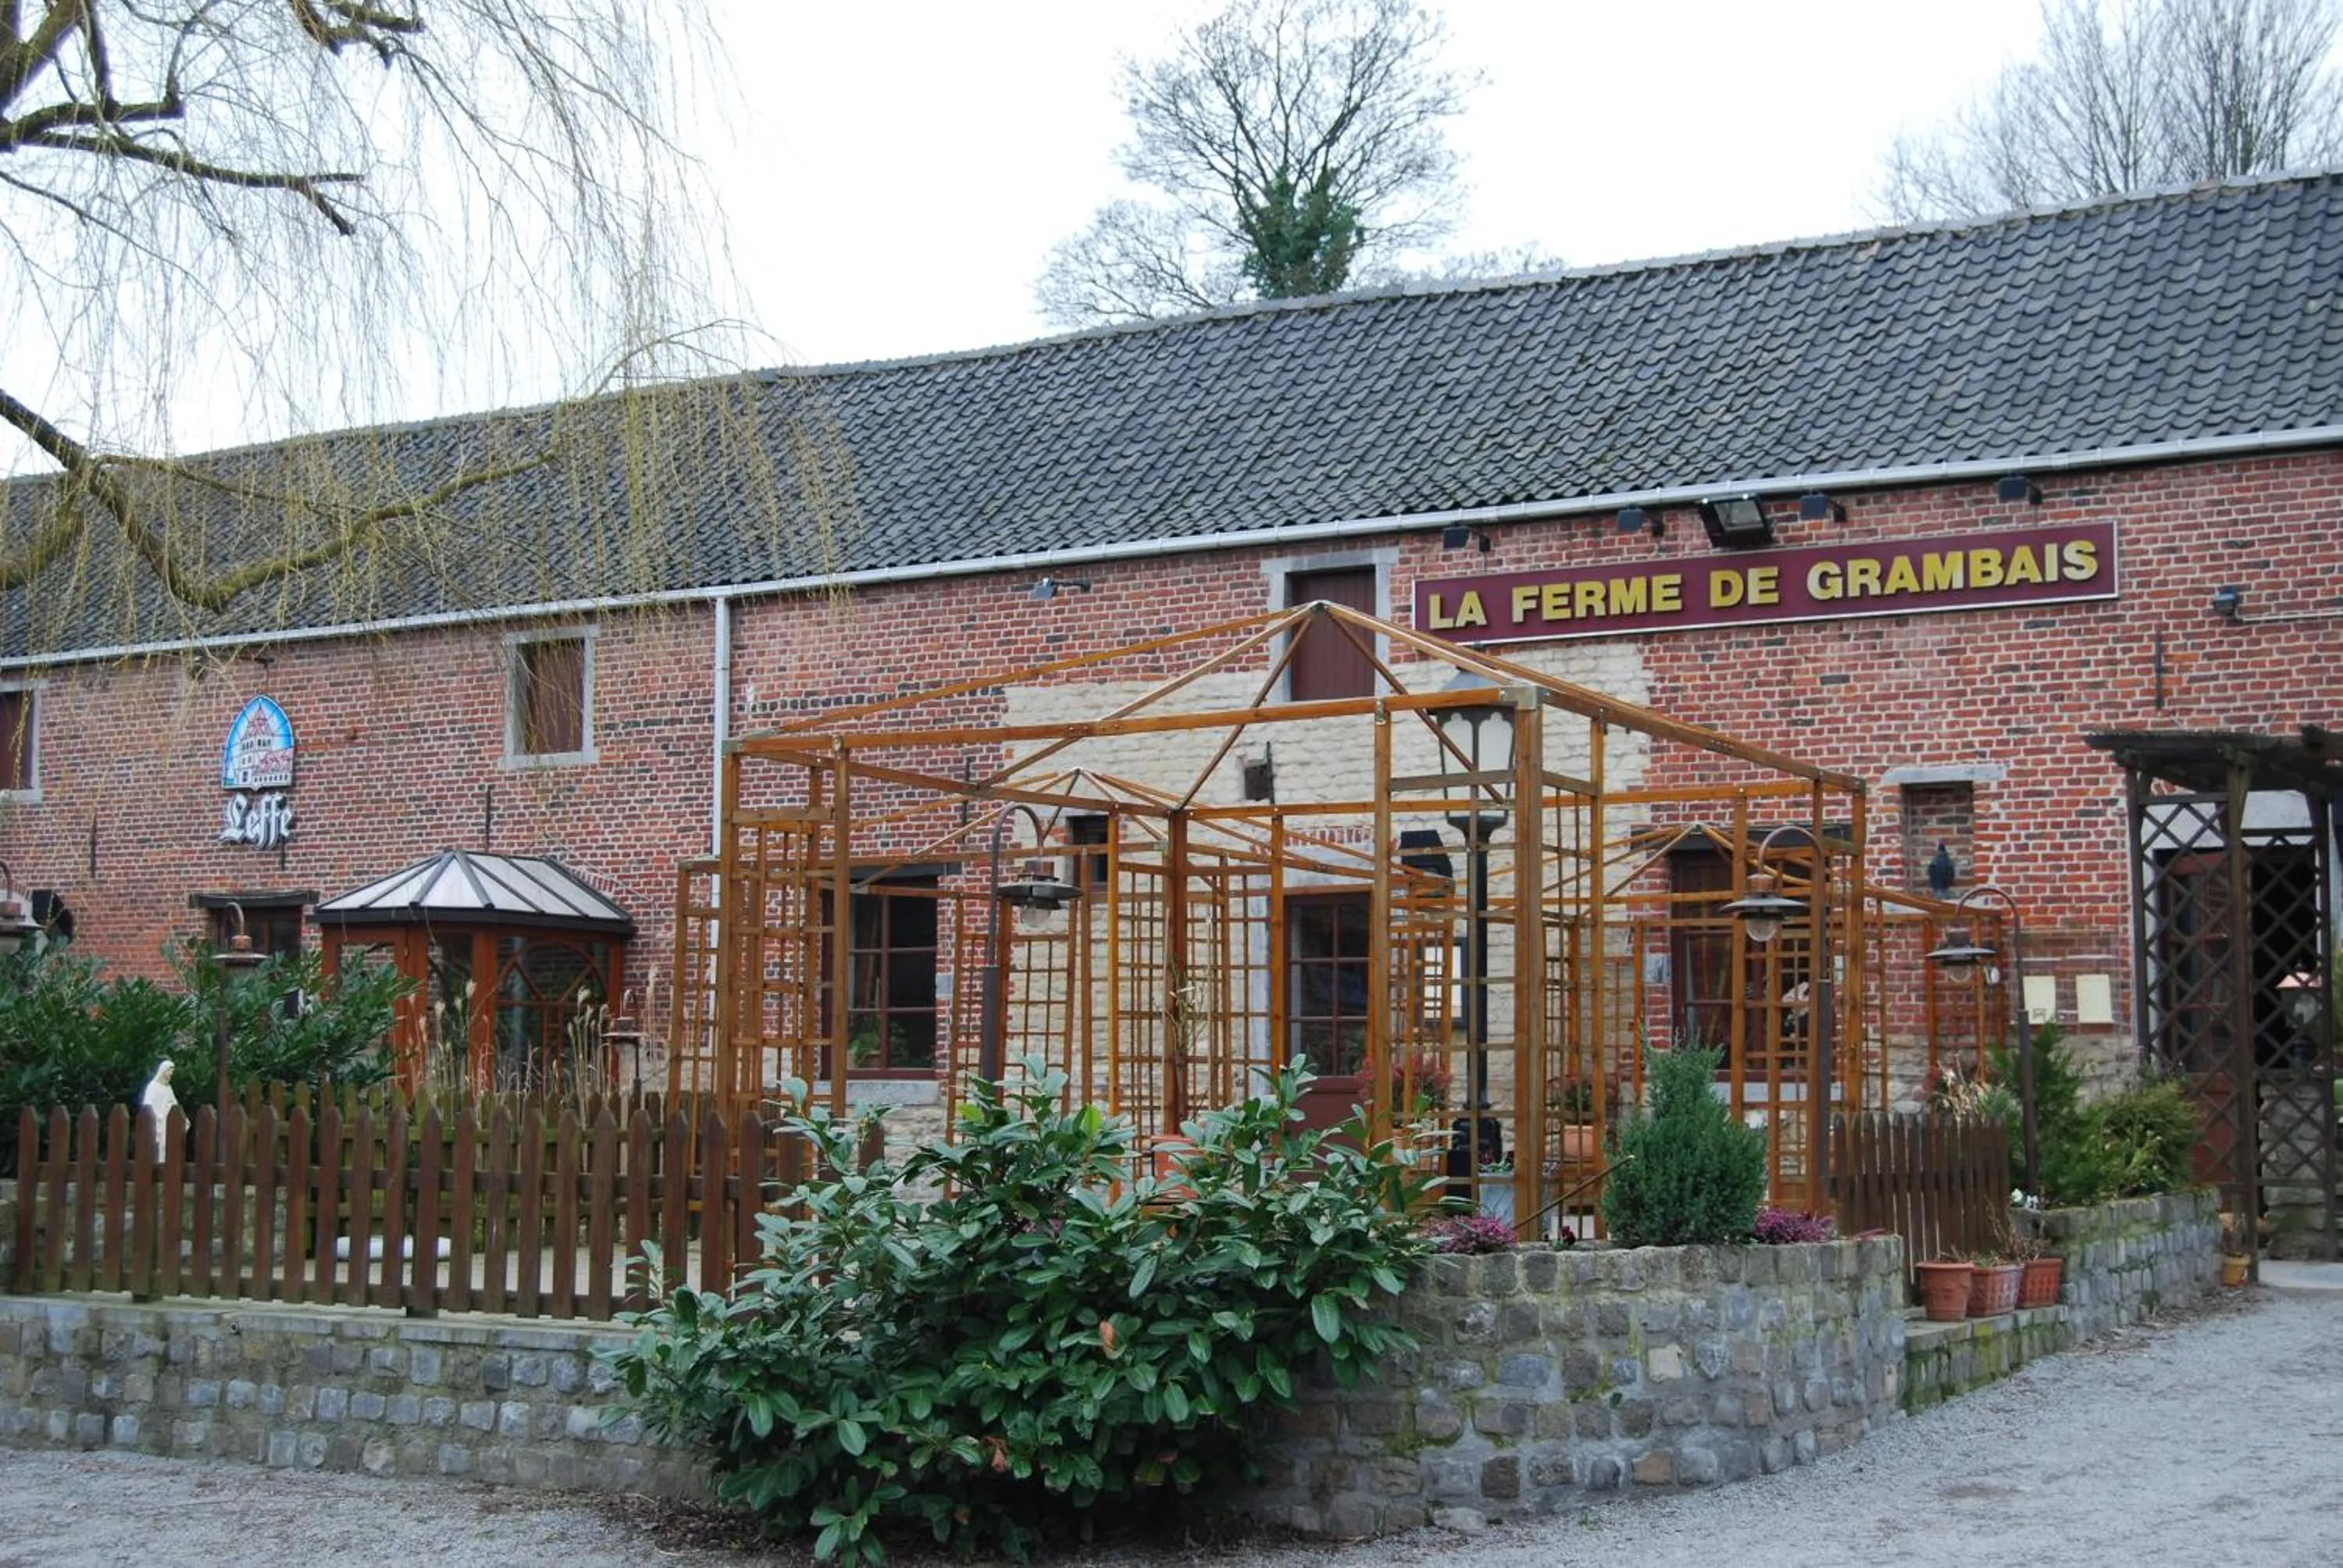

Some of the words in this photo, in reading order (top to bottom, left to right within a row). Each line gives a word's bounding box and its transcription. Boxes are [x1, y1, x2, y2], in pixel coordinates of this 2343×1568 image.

[1429, 590, 1487, 629] LA
[1512, 574, 1681, 623] FERME
[1710, 566, 1778, 608] DE
[1806, 540, 2099, 600] GRAMBAIS
[219, 792, 293, 850] Leffe
